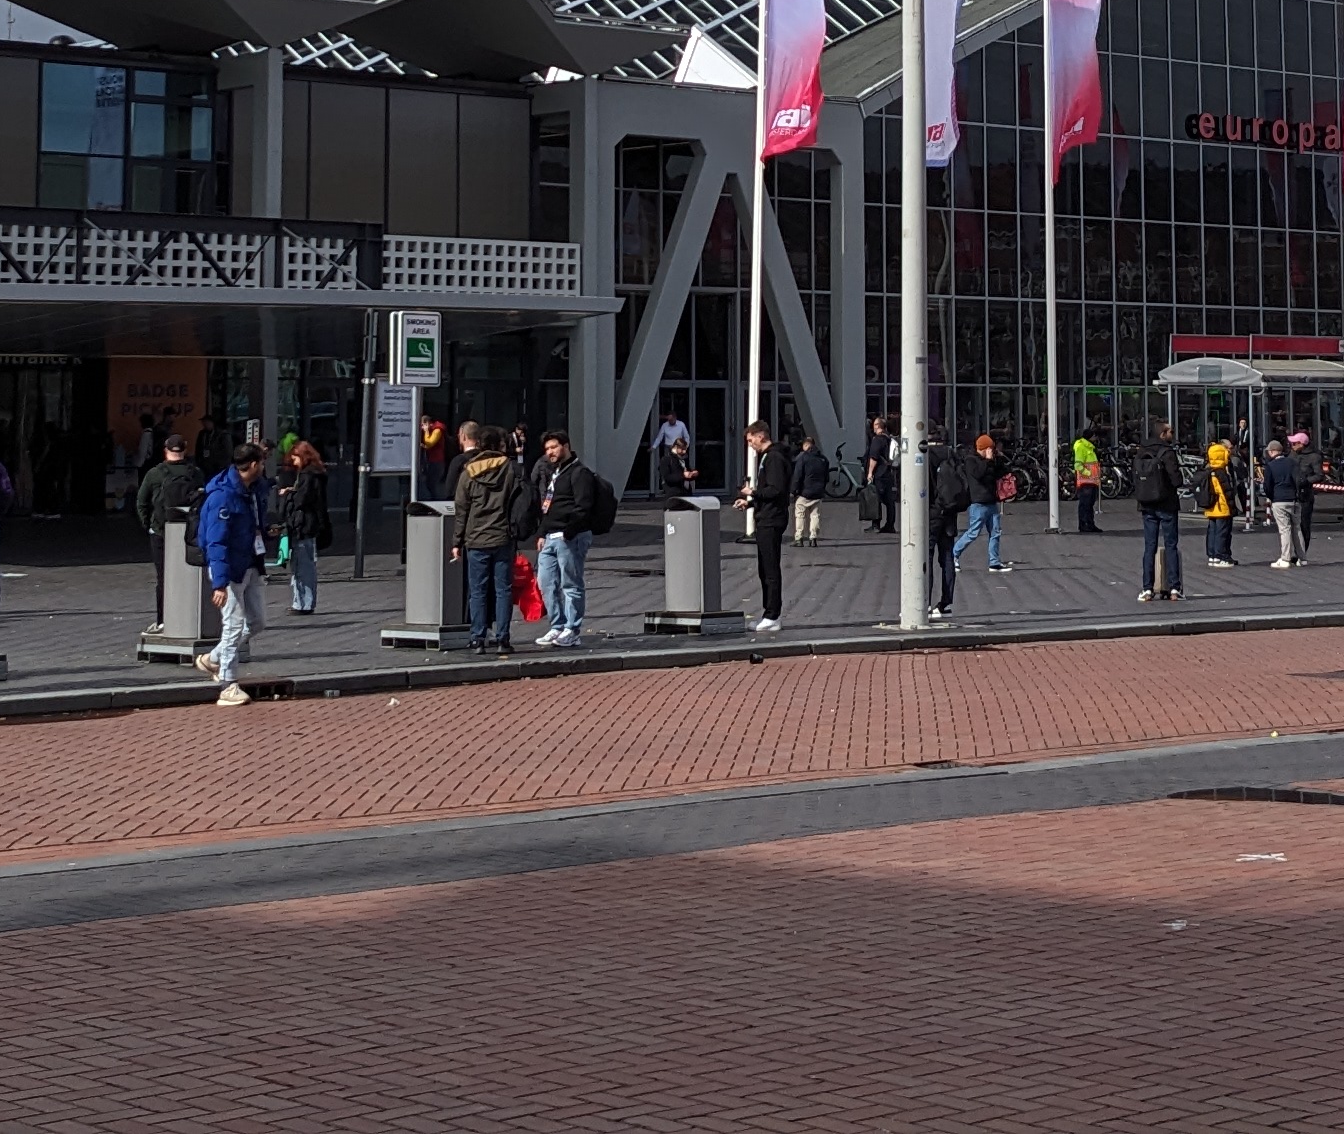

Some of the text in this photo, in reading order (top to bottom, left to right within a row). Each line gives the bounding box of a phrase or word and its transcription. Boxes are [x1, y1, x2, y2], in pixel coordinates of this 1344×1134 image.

[406, 318, 436, 326] SMOKING
[411, 327, 431, 335] AREA
[127, 384, 189, 398] BADGE
